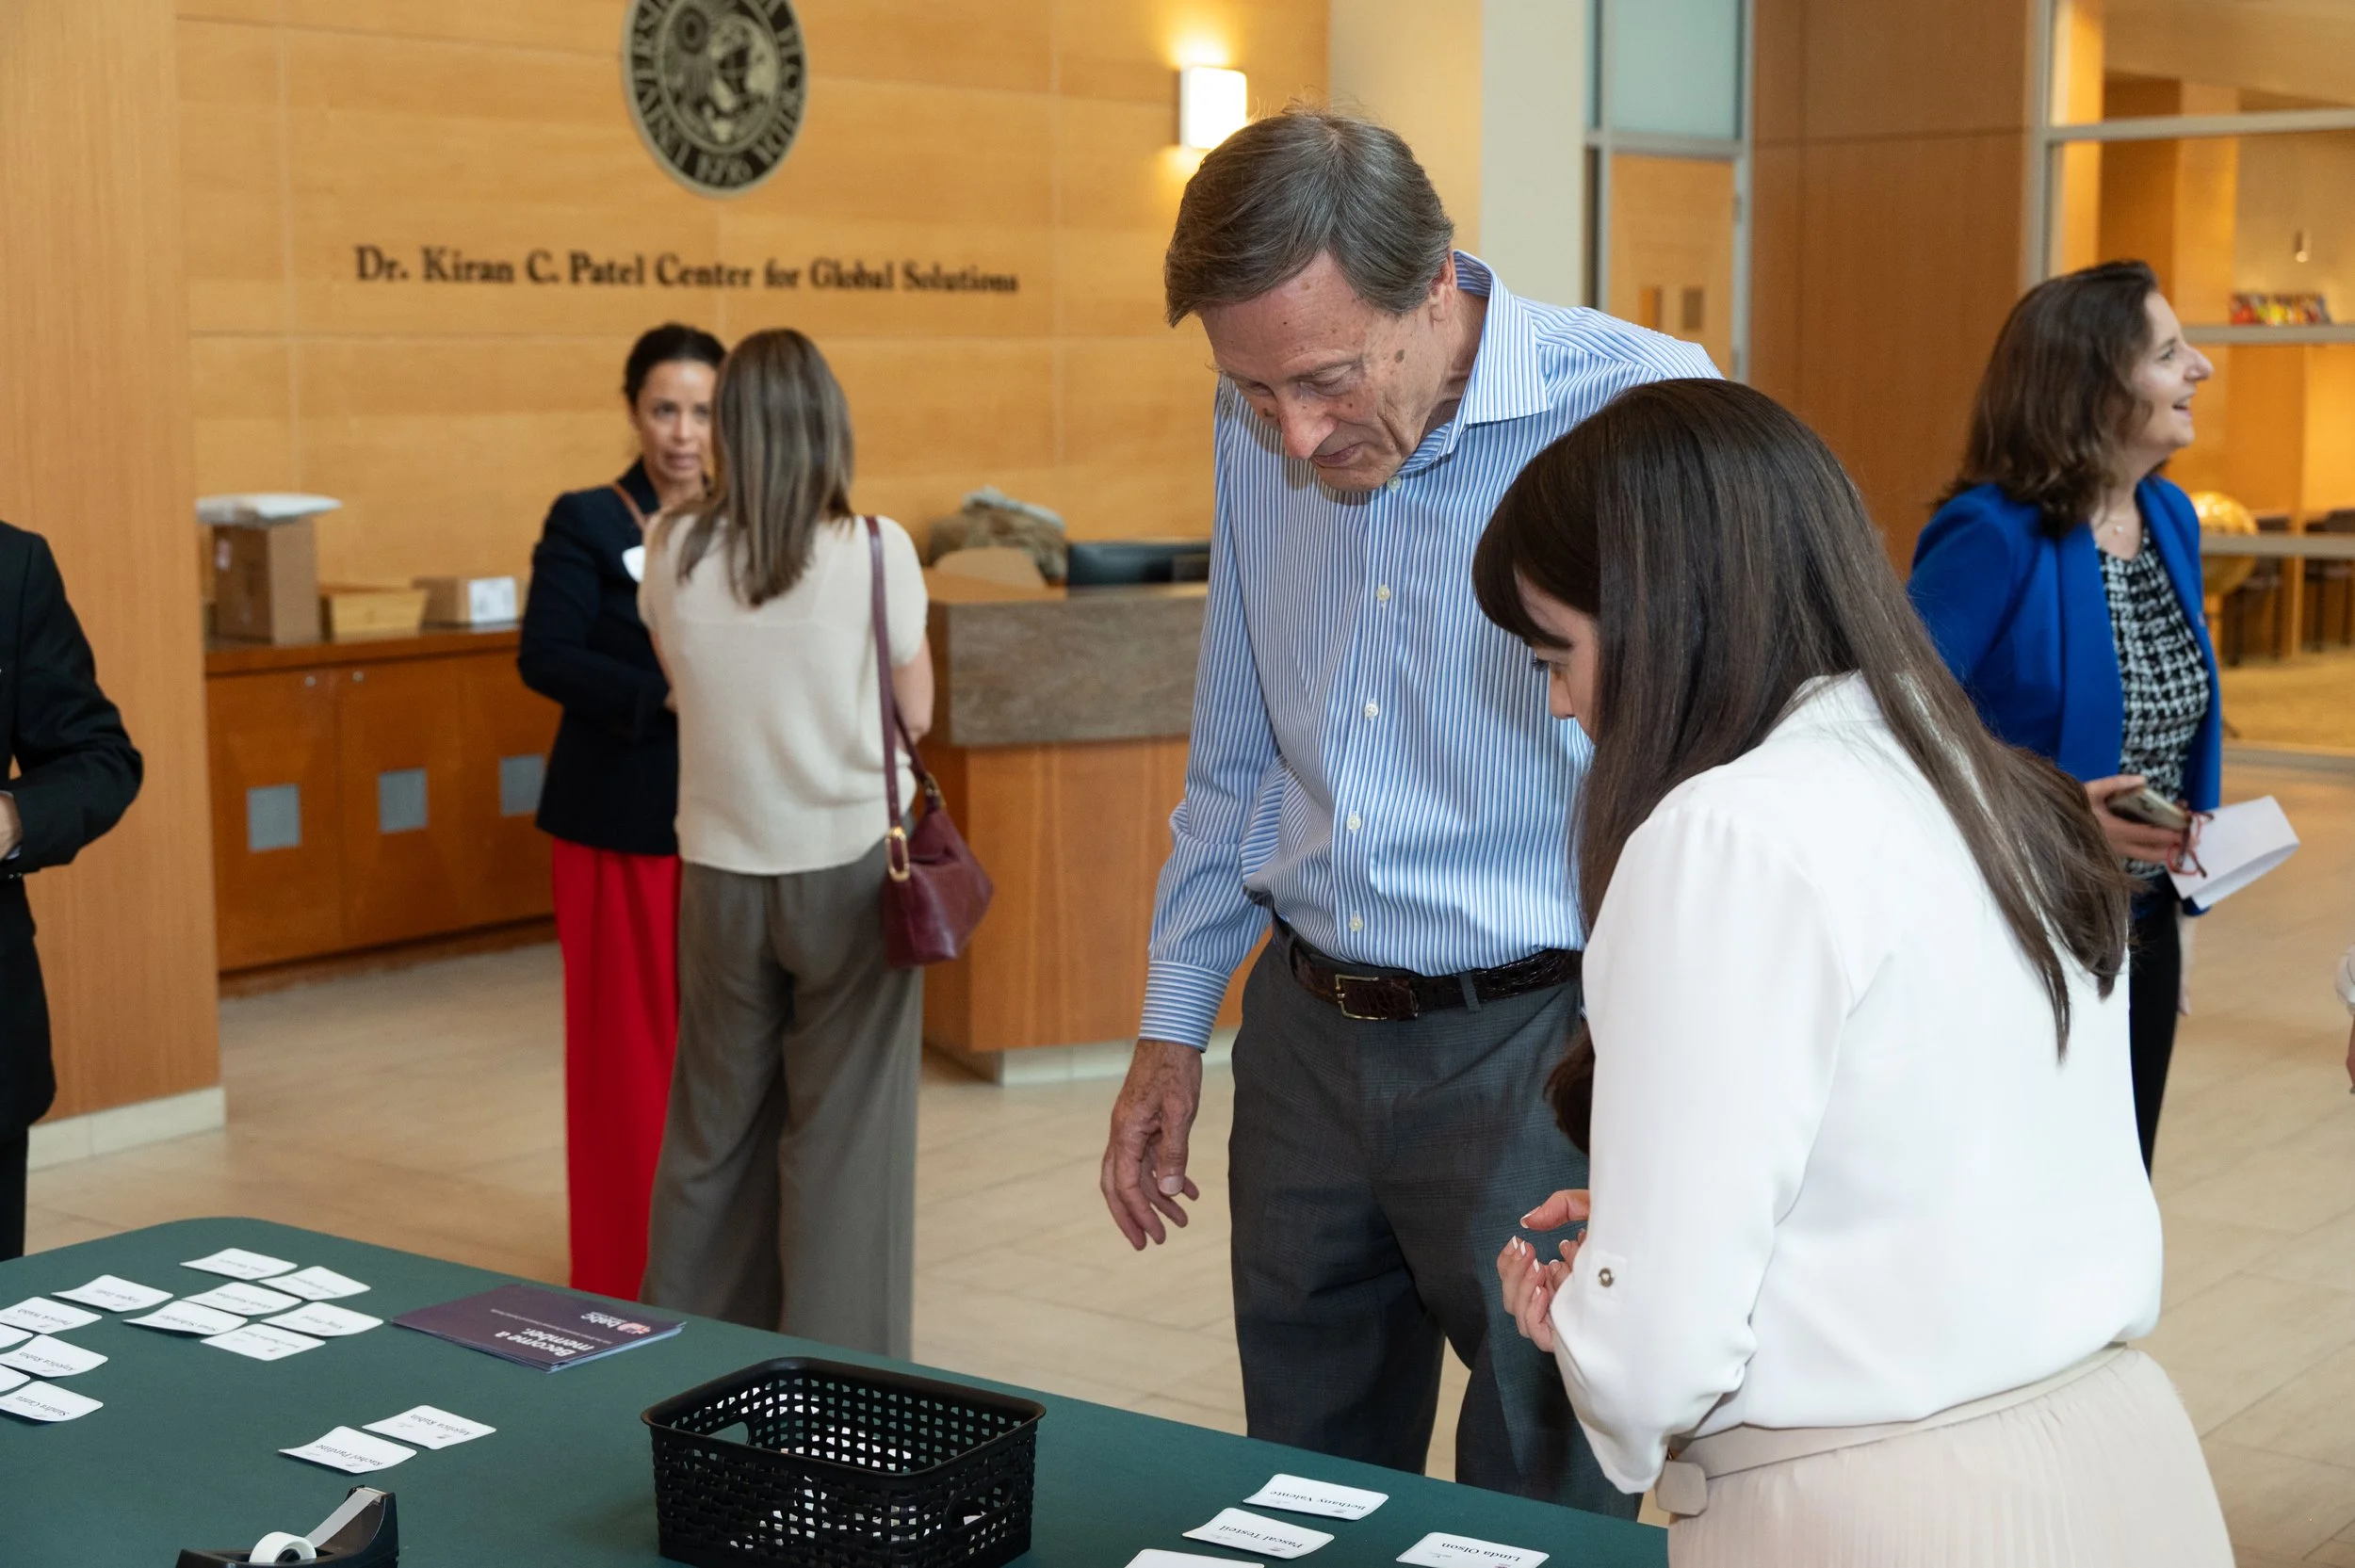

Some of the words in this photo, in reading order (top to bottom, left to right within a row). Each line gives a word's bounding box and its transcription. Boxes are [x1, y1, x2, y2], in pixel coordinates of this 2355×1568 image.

[355, 244, 409, 282] Dr.
[422, 244, 515, 283] Kiran
[525, 248, 560, 284] C.
[569, 249, 646, 285] Patel
[654, 251, 755, 287] Center
[764, 257, 801, 290] for
[809, 256, 895, 291] Global
[901, 259, 1020, 294] Solutions
[507, 1333, 576, 1357] Become
[524, 1328, 595, 1351] member.
[410, 1414, 437, 1427] Rubin
[436, 1423, 473, 1436] Angelica
[352, 1454, 383, 1466] Rachel
[1270, 1491, 1313, 1503] Valente
[1317, 1497, 1367, 1511] Bethany
[1262, 1534, 1304, 1548] Pascal
[1441, 1543, 1480, 1555] Olson
[1484, 1549, 1522, 1561] Linda
